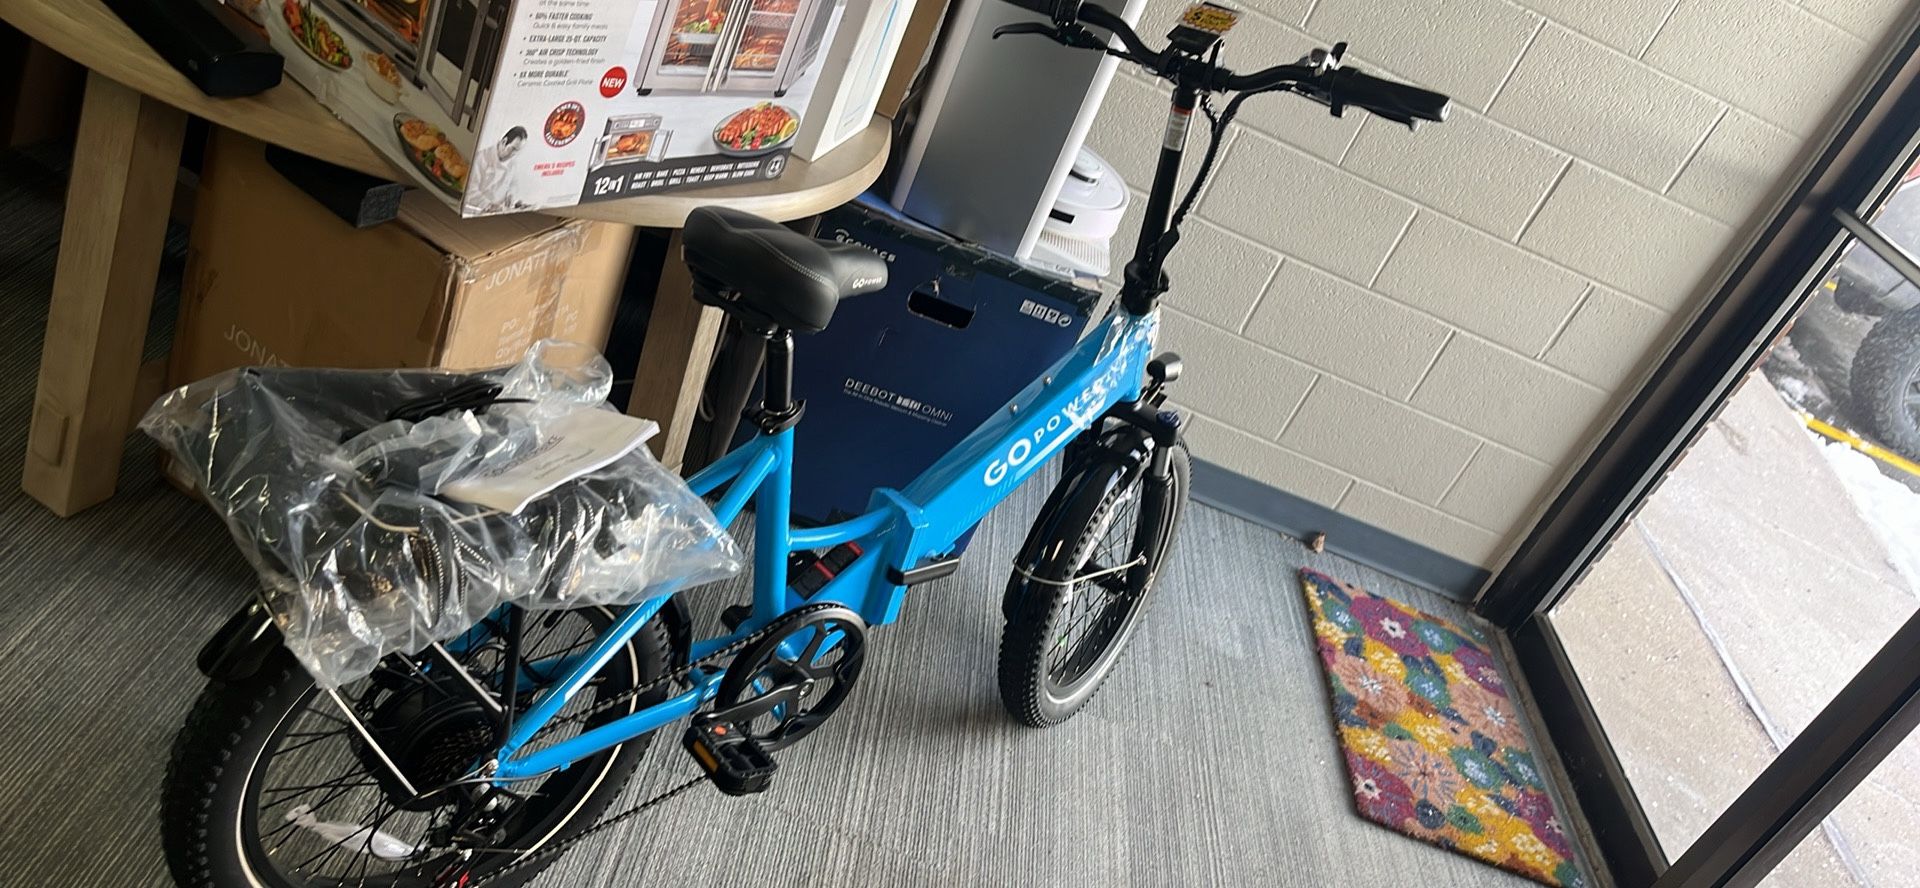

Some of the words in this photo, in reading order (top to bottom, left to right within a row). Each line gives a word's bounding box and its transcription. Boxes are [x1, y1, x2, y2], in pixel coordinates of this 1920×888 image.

[548, 12, 569, 20] FASTER
[569, 12, 593, 20] COOKING
[572, 22, 590, 31] family
[583, 35, 608, 43] CAPACITY
[538, 48, 548, 56] AIR
[549, 48, 565, 56] CRISP
[566, 48, 599, 56] TECHNOLOGY
[545, 70, 569, 78] DURABLE
[517, 80, 543, 88] Ceramic
[602, 77, 625, 88] NEW
[541, 169, 565, 177] INCLUDED
[633, 172, 642, 180] AIR
[642, 171, 653, 180] FRY
[656, 169, 669, 178] BAKE
[672, 168, 686, 176] PIZZA
[630, 181, 647, 190] ROAST
[668, 177, 682, 186] GRILL
[685, 175, 701, 183] TOAST
[702, 173, 715, 182] KEEP
[714, 171, 729, 180] WARM
[731, 170, 745, 179] SLOW
[844, 377, 897, 402] DEEBOT
[921, 404, 954, 422] OMNI
[983, 438, 1032, 487] GO
